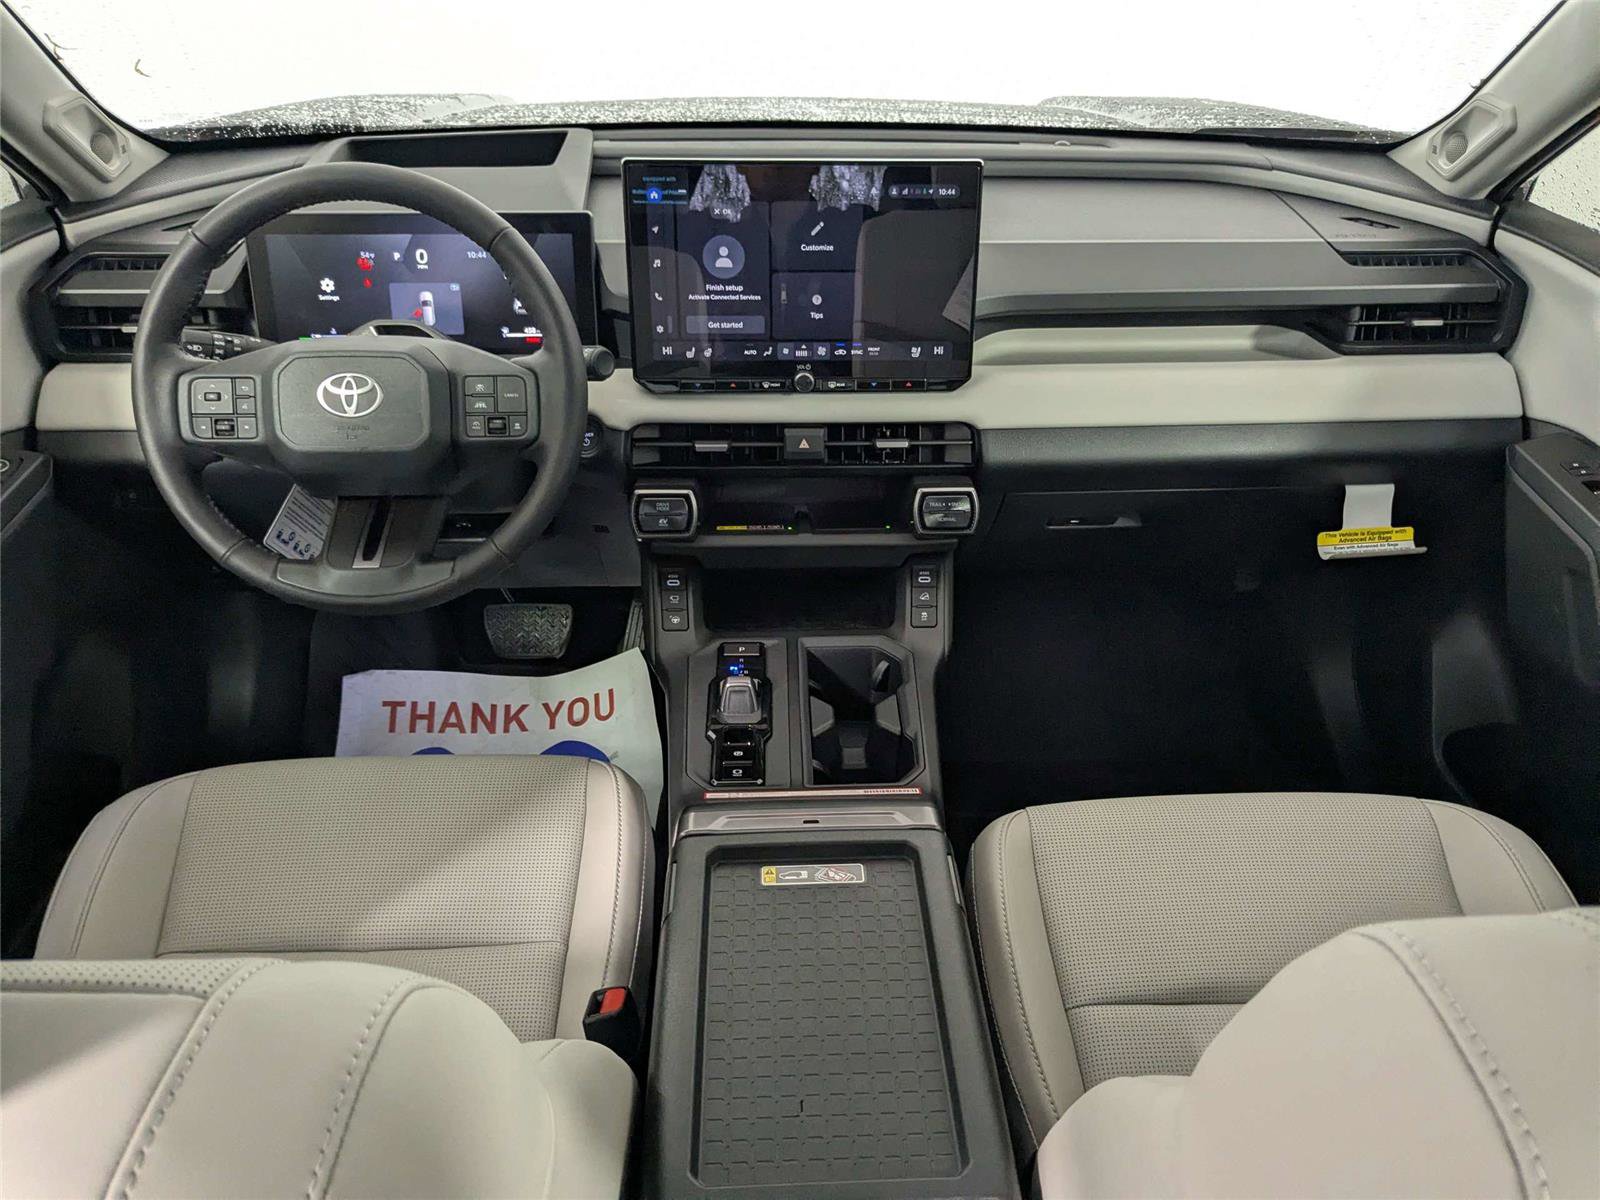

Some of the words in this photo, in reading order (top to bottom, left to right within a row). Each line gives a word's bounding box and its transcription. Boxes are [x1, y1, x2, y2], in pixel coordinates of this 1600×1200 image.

[938, 187, 956, 196] 10:44
[800, 244, 834, 252] Customize
[392, 252, 401, 261] P
[415, 248, 428, 264] 0
[466, 251, 487, 259] 10:44
[810, 312, 824, 320] Tips
[707, 321, 720, 329] Get
[720, 321, 744, 329] started
[1366, 529, 1393, 537] Equipped
[381, 700, 531, 735] THANK
[541, 688, 616, 731] YOU
